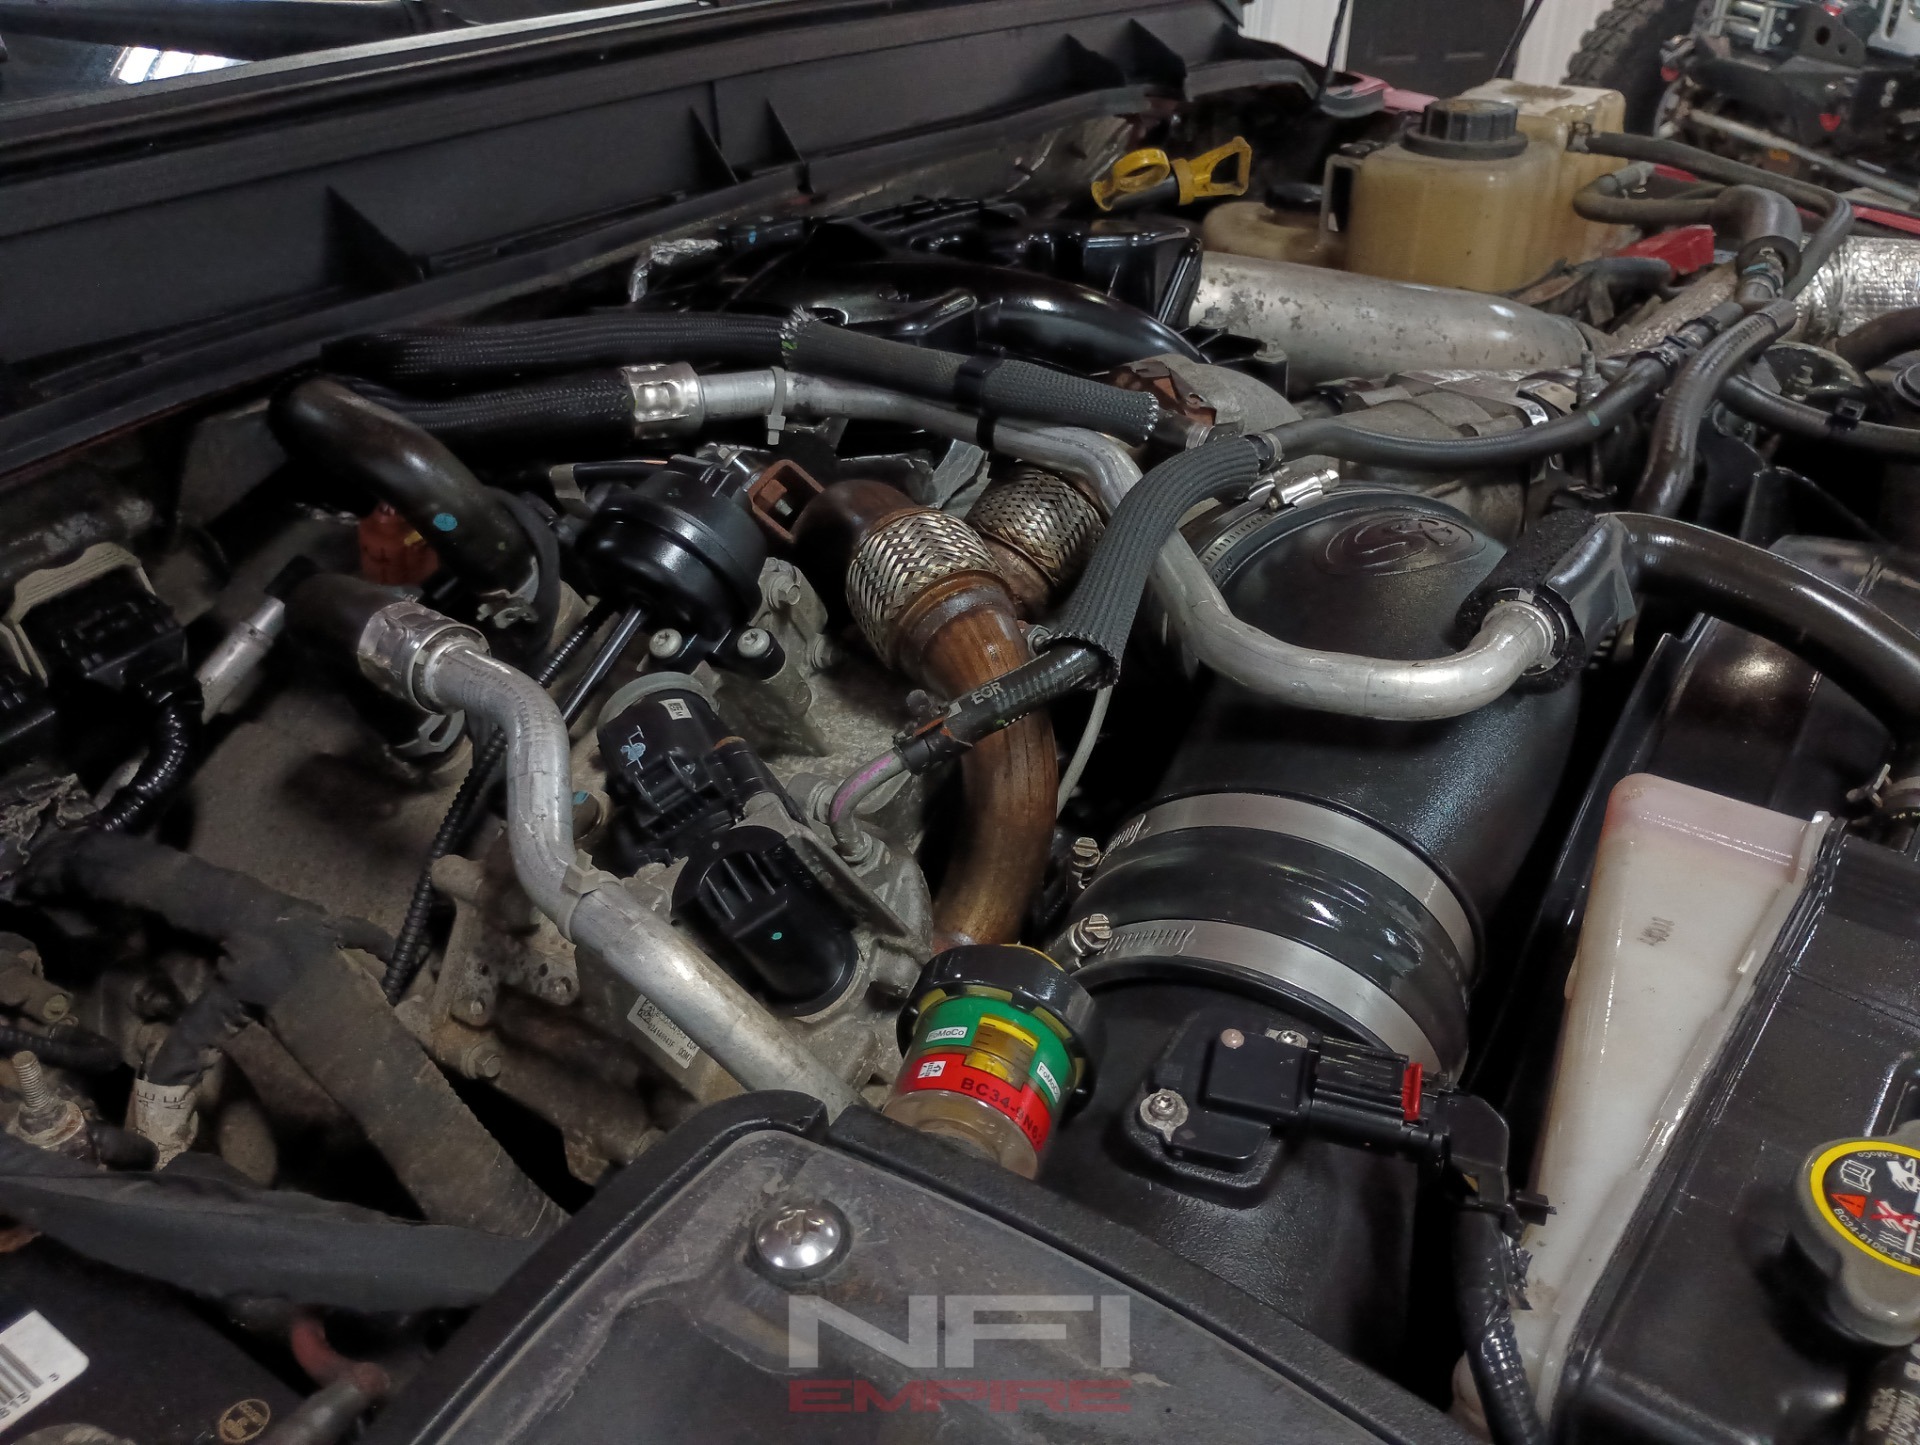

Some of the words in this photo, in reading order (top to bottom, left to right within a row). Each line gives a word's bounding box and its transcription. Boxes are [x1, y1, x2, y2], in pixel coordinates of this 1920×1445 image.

[971, 681, 1004, 705] EGR
[928, 1029, 965, 1040] FoMoCo
[1857, 1151, 1899, 1160] FoMoCo
